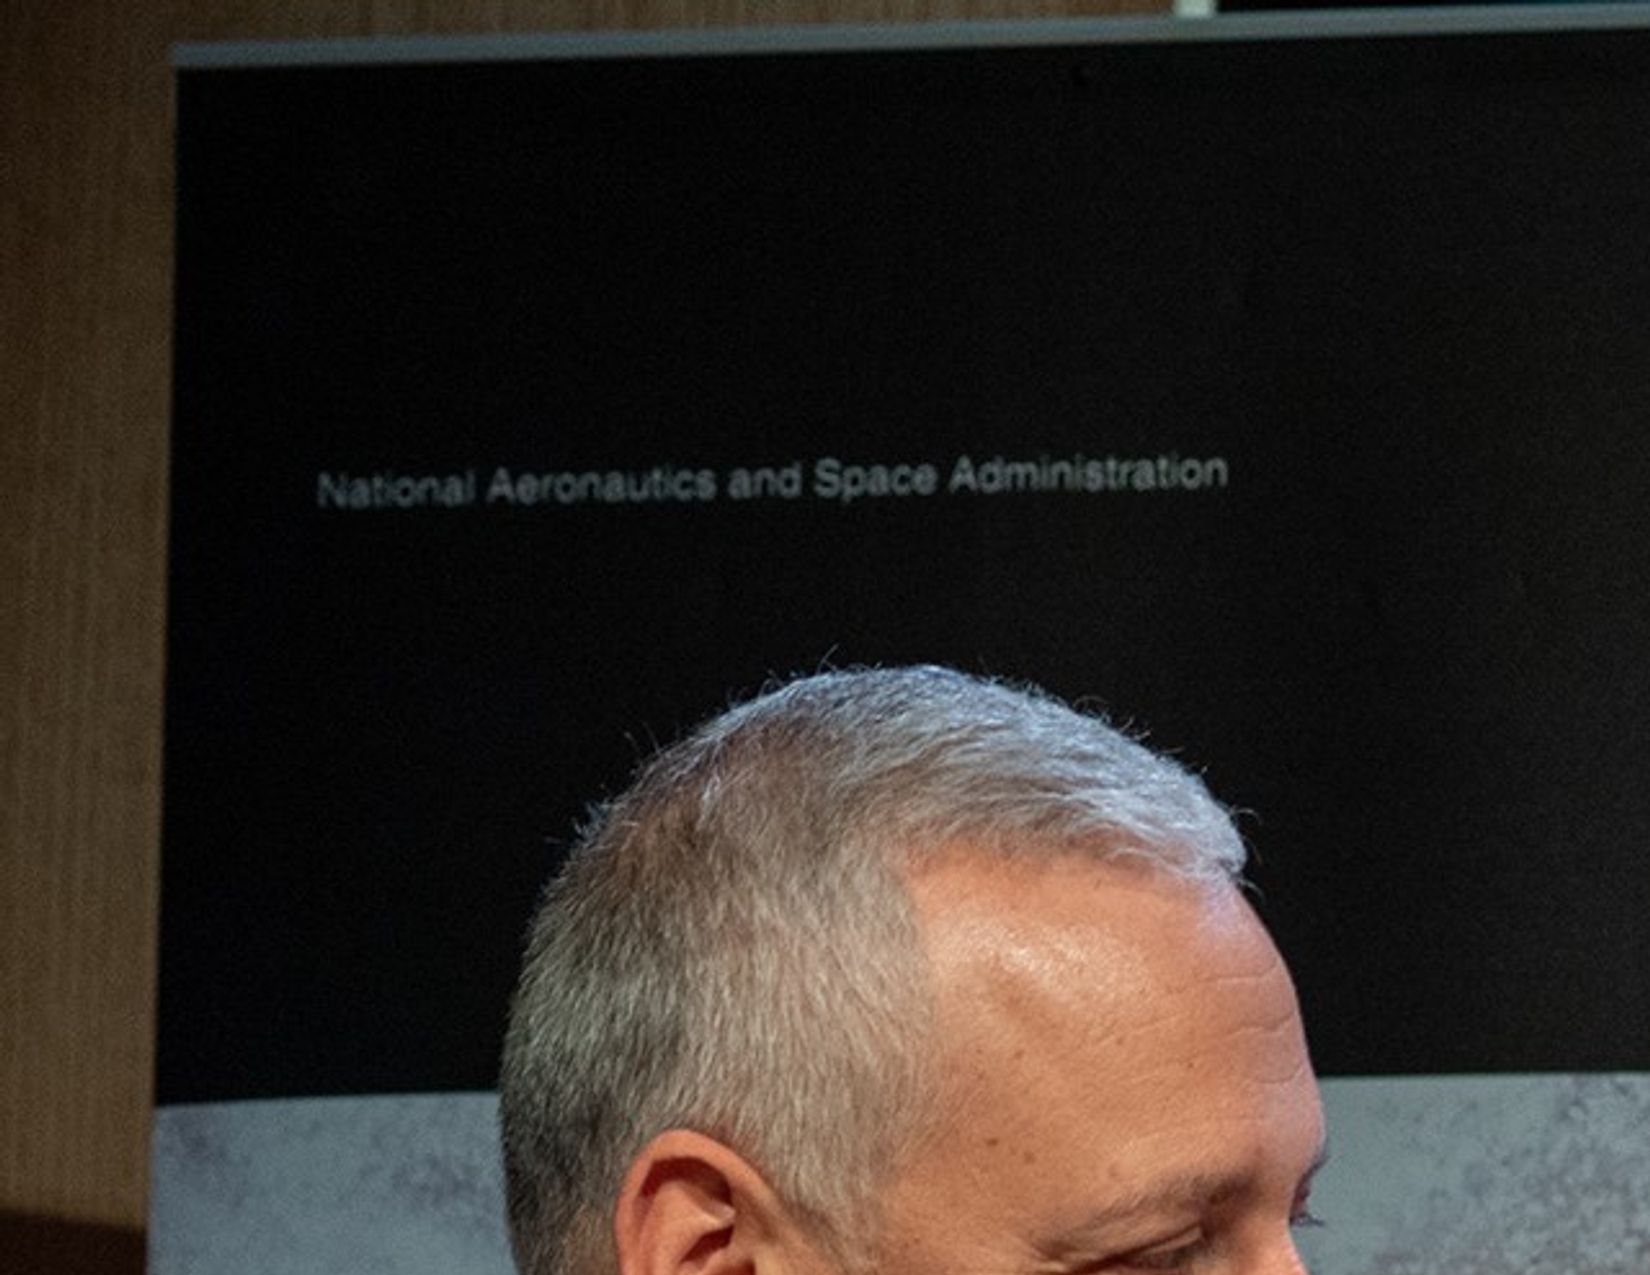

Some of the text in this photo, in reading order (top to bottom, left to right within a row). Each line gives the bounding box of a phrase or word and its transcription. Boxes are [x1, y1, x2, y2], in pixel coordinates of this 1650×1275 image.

[318, 453, 1228, 507] National Aeronautics and Space Administration
